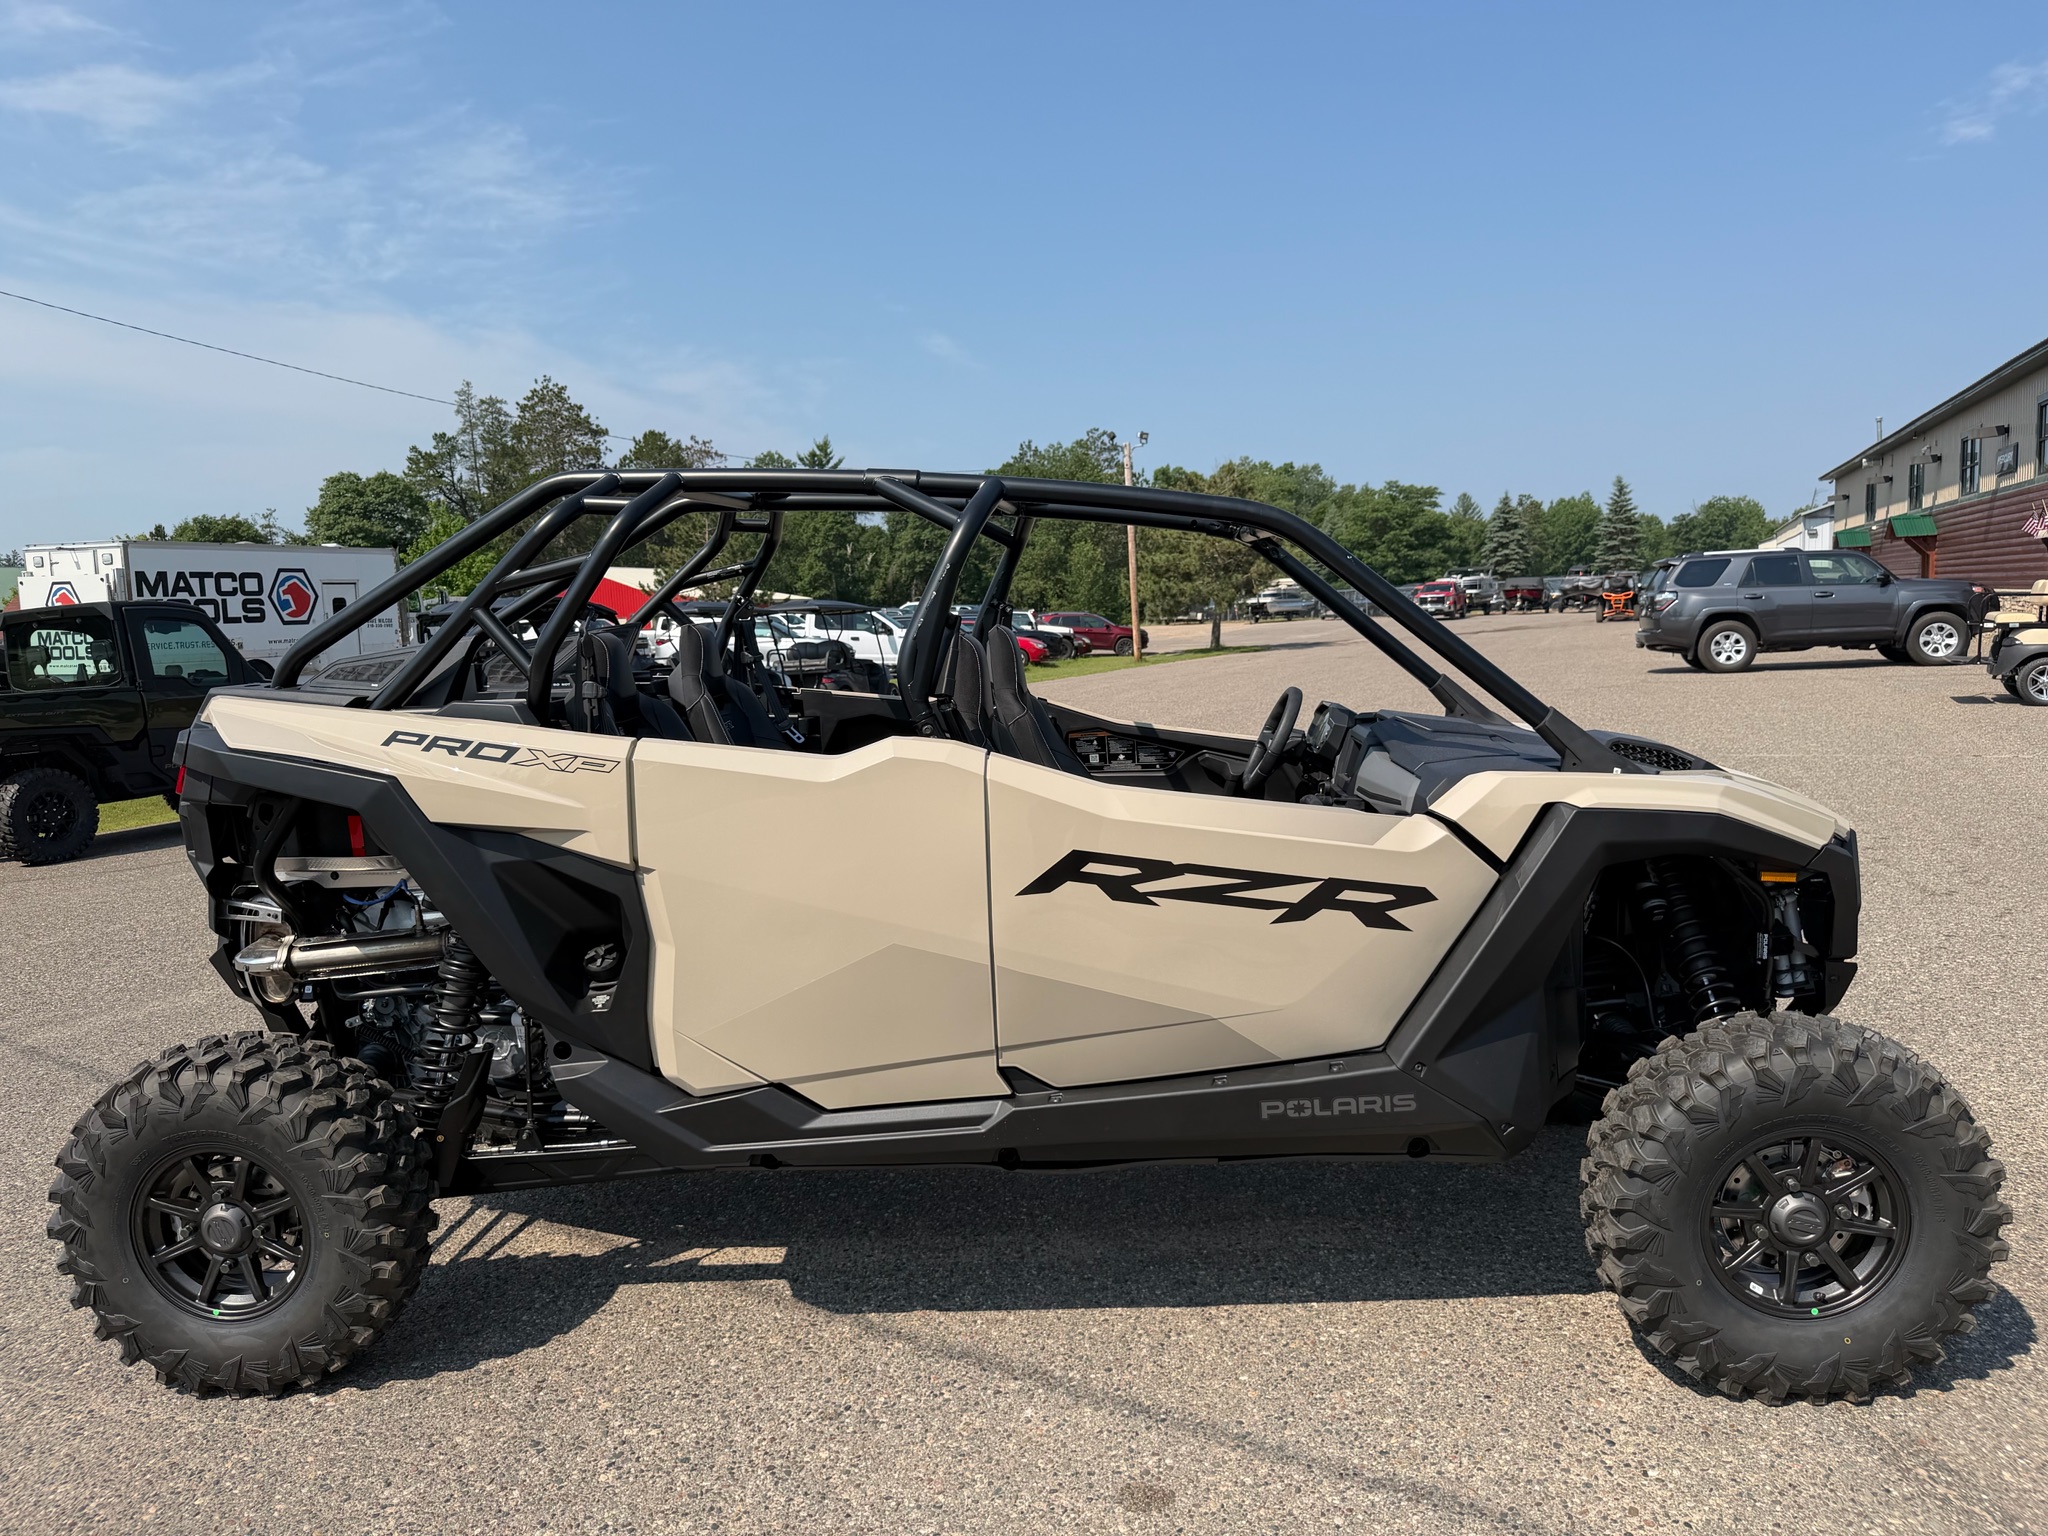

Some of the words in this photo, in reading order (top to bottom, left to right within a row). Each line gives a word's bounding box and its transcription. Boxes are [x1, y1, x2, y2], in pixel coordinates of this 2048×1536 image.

[134, 570, 265, 598] MATCO
[50, 646, 94, 661] OOLS
[1015, 849, 1439, 932] RZR
[1260, 1093, 1417, 1120] POLARIS
